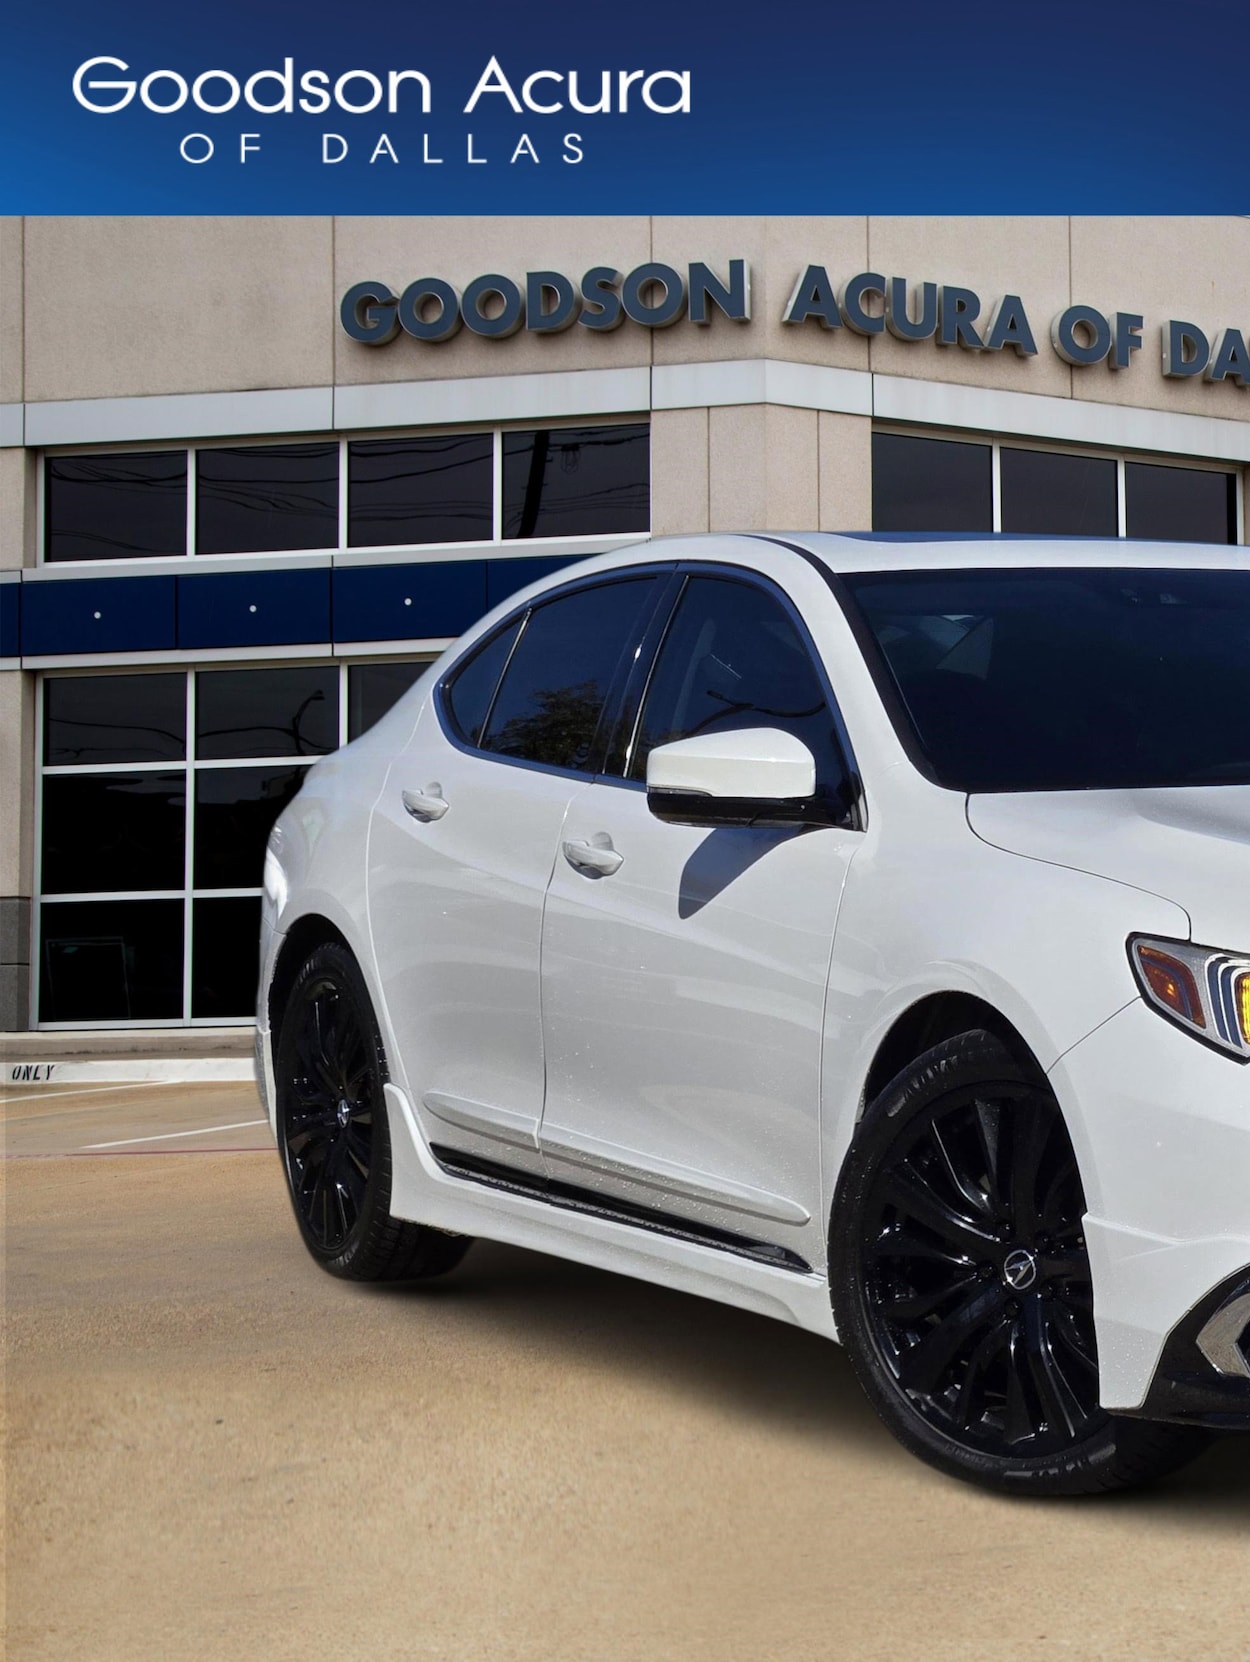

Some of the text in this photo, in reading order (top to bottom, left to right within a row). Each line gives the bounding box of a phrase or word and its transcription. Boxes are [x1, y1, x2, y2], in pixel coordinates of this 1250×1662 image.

[340, 258, 751, 348] GOODSON
[782, 263, 1038, 357] ACURA
[1051, 304, 1144, 371] OF
[11, 1064, 55, 1081] ONLY
